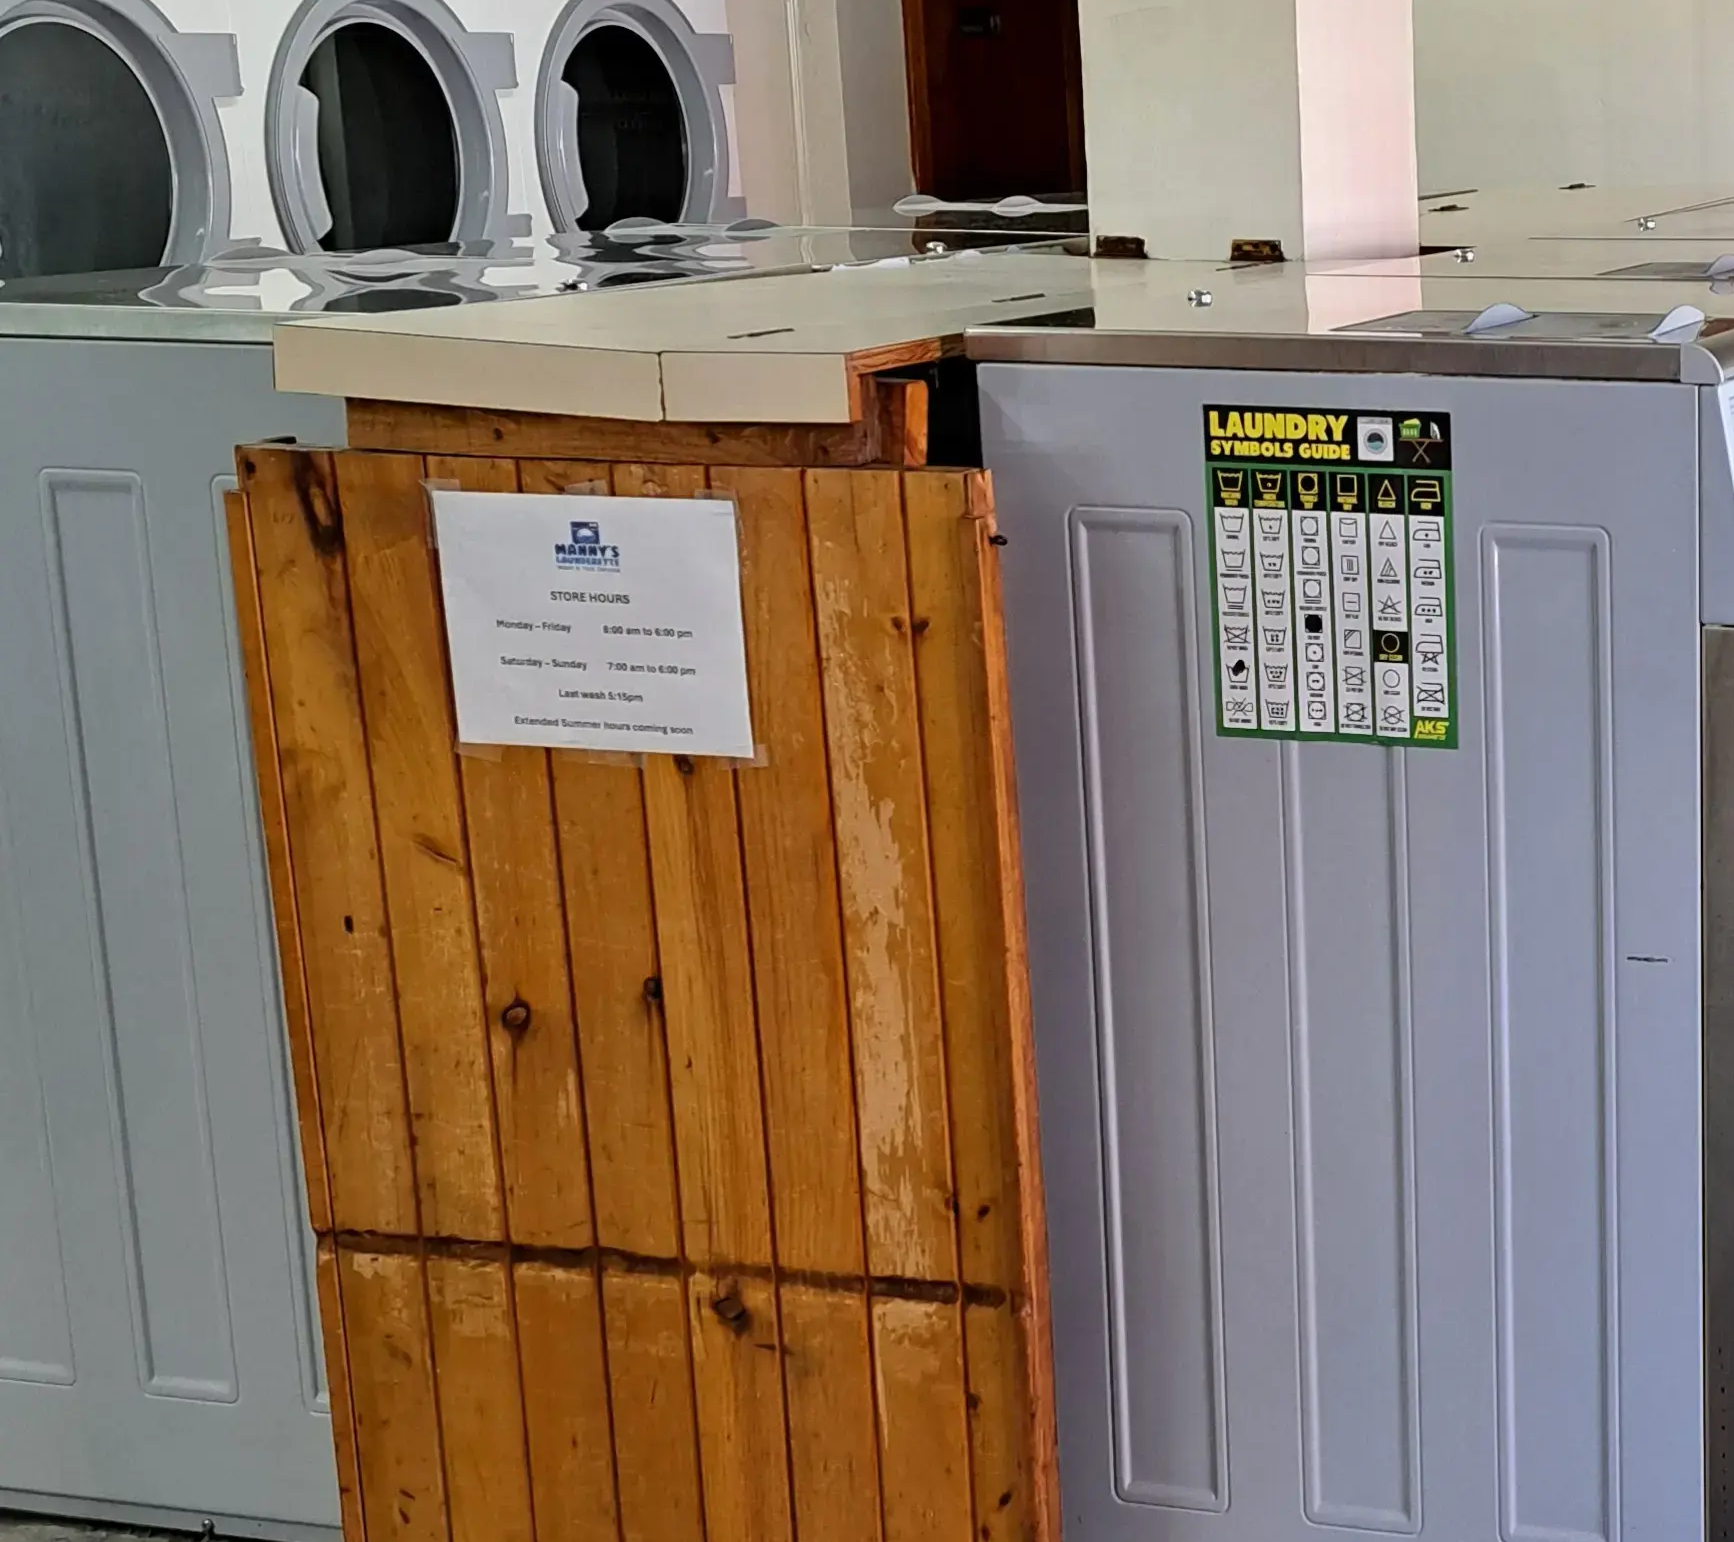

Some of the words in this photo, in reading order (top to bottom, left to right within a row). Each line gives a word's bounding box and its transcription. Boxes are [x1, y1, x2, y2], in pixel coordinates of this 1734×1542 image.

[1208, 410, 1348, 442] LAUNDRY
[1211, 439, 1293, 458] SYMBOLS
[1299, 444, 1350, 460] GUIDE
[550, 591, 586, 602] STORE
[588, 593, 630, 605] HOURS
[496, 619, 533, 631] Monday
[542, 621, 572, 634] Friday
[642, 627, 652, 636] to
[677, 631, 693, 639] pm
[500, 656, 542, 669] Saturday
[552, 659, 587, 671] Sunday
[646, 665, 656, 673] to
[680, 667, 696, 677] pm
[1414, 719, 1450, 738] AKS
